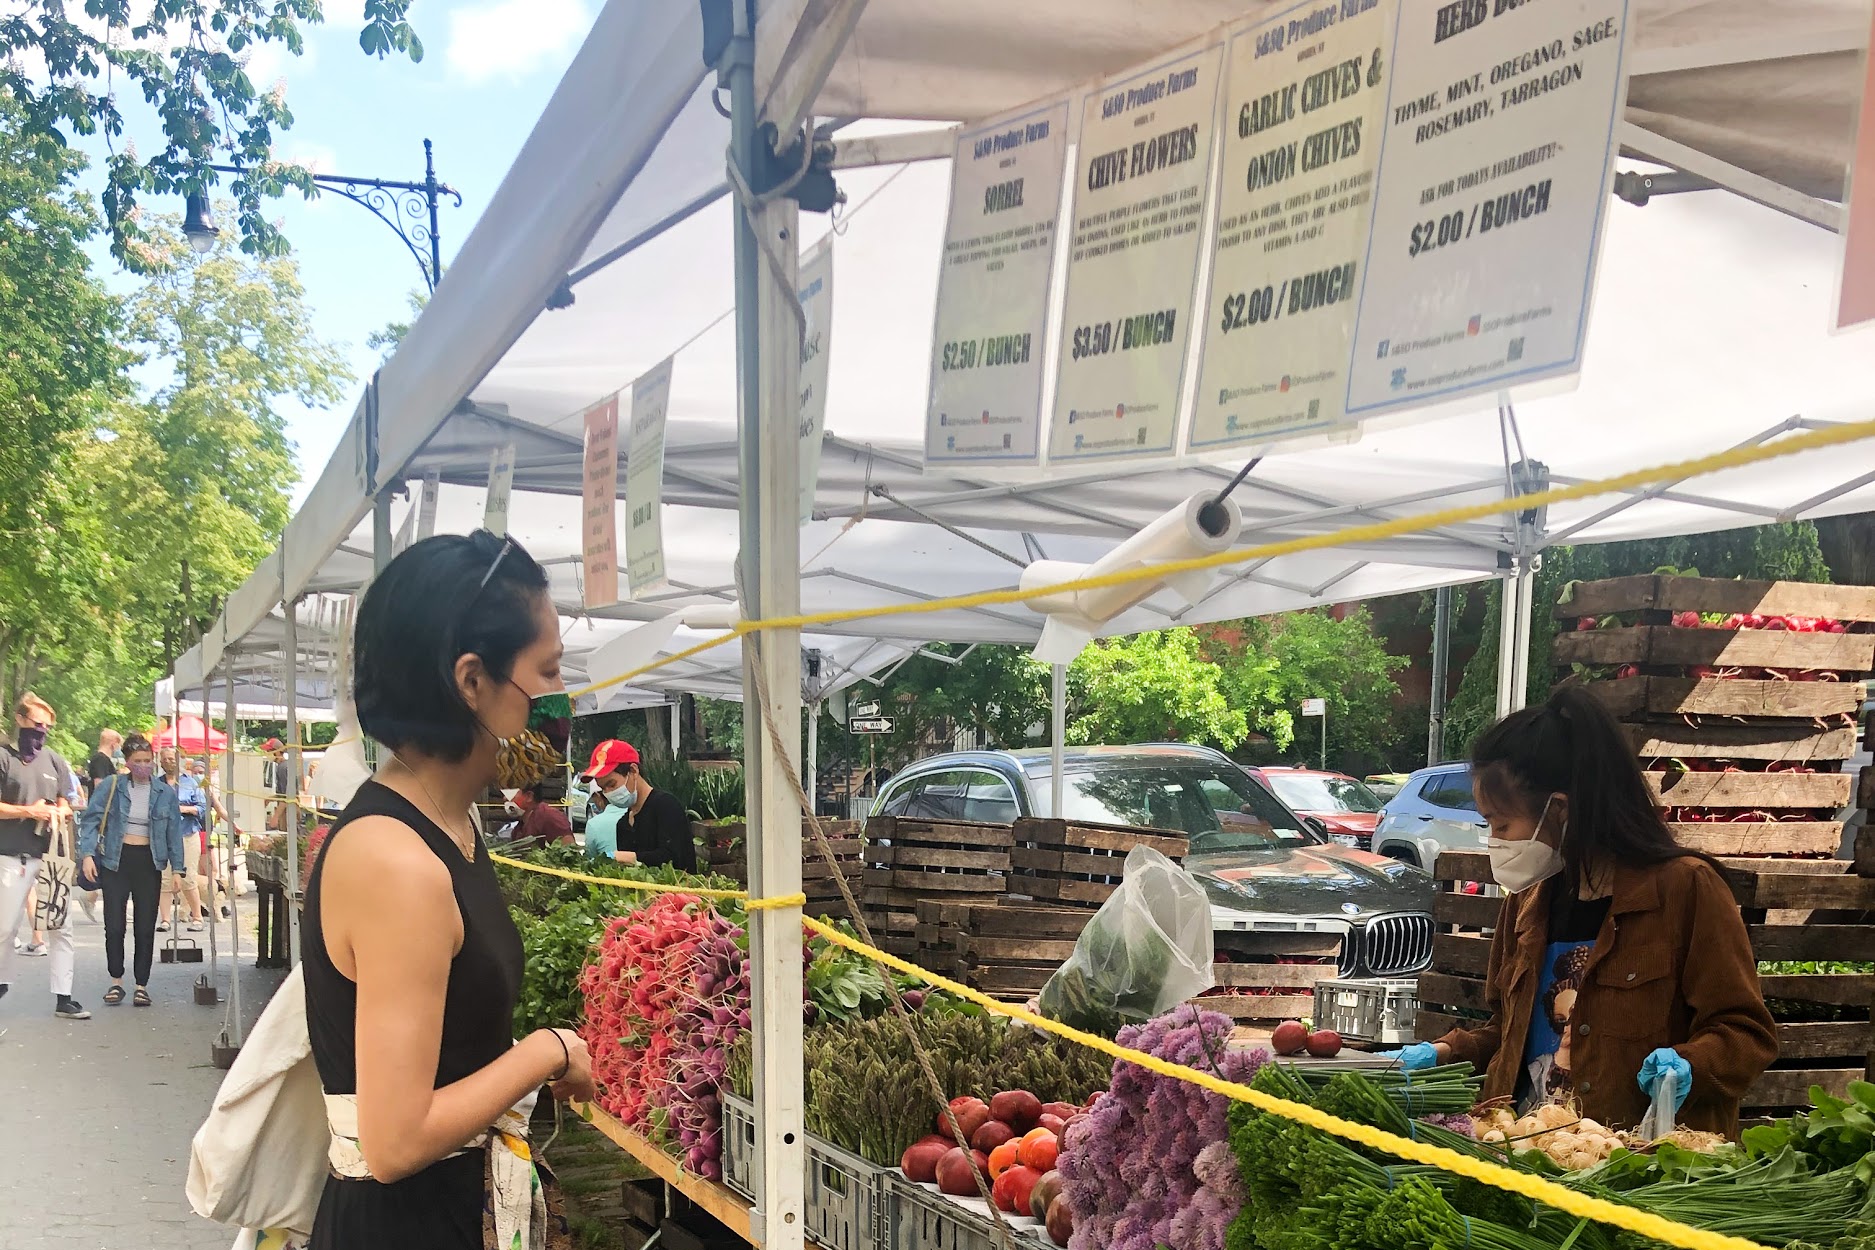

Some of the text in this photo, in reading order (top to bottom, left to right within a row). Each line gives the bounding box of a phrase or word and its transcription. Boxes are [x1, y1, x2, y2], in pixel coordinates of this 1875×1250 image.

[1286, 4, 1337, 45] Produce
[1434, 0, 1488, 44] HERB
[1126, 79, 1166, 112] Produce
[1166, 66, 1199, 96] Farms
[1238, 46, 1384, 140] GARLIC CHIVES &
[1394, 16, 1618, 126] THYME, MINT, OREGANO, SAGE,
[1415, 60, 1584, 145] ROSEMARY, TARRAGON
[993, 128, 1024, 155] Produce
[1025, 120, 1050, 143] Farms
[1088, 122, 1199, 193] CHIVE FLOWERS
[1246, 115, 1363, 193] ONION CHIVES
[983, 177, 1025, 216] SORREL
[1284, 190, 1311, 211] CHIVES
[1314, 184, 1331, 201] ADD
[1331, 181, 1338, 196] A
[1436, 179, 1454, 200] FOR
[1456, 165, 1490, 193] TODAYS
[1263, 235, 1292, 253] VITAMIN
[1300, 225, 1317, 242] AND
[1408, 177, 1553, 259] $2.00 / BUNCH
[1221, 260, 1357, 335] $2.00 / BUNCH
[942, 332, 1031, 373] $2.50 / BUNCH
[1072, 308, 1177, 363] $3.50 / BUNCH
